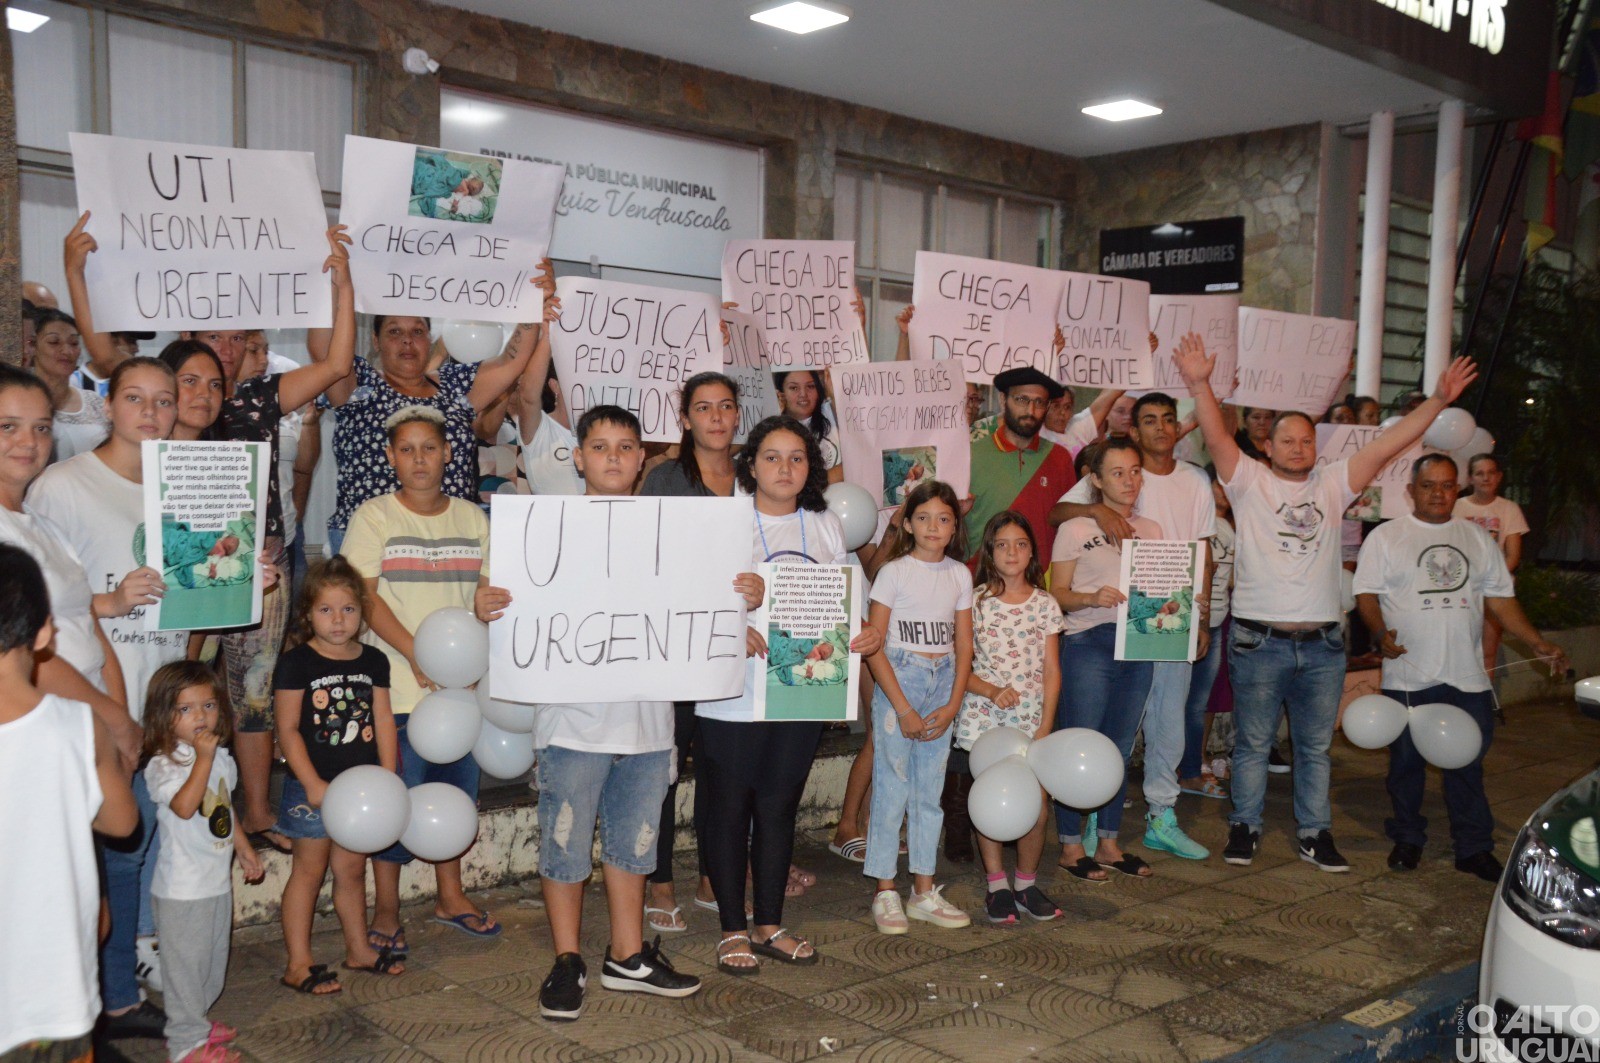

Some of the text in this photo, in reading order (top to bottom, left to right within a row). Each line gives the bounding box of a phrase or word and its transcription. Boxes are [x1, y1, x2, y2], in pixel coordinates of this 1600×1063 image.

[148, 152, 234, 202] UTI
[577, 163, 717, 202] PÚBLICA MUNICIPAL
[605, 188, 732, 232] Vendruscolo
[121, 212, 296, 252] NEONATAL
[362, 224, 509, 260] CHEGA DE
[736, 248, 848, 288] CHEGA DE
[1103, 244, 1236, 272] CÂMARA DE VEREADORES
[136, 270, 308, 320] URGENTE
[383, 270, 528, 309] DESCASO!!
[938, 270, 1031, 313] CHEGA
[1066, 278, 1123, 324] UTI
[559, 290, 710, 354] JUSTIÇA
[752, 292, 842, 330] PERDER
[963, 312, 992, 332] DE
[804, 331, 863, 366] BEBÊS!!
[1062, 326, 1132, 350] EONATAL
[1242, 313, 1352, 356] UTI PELA
[575, 344, 696, 383] PELO BEBÊ
[841, 362, 952, 400] QUANTOS BEBÊS
[1058, 354, 1140, 385] RGENTE
[845, 406, 908, 433] PRECISAM
[524, 498, 662, 587] UTI
[512, 610, 738, 671] URGENTE
[310, 674, 344, 690] SPOOKY
